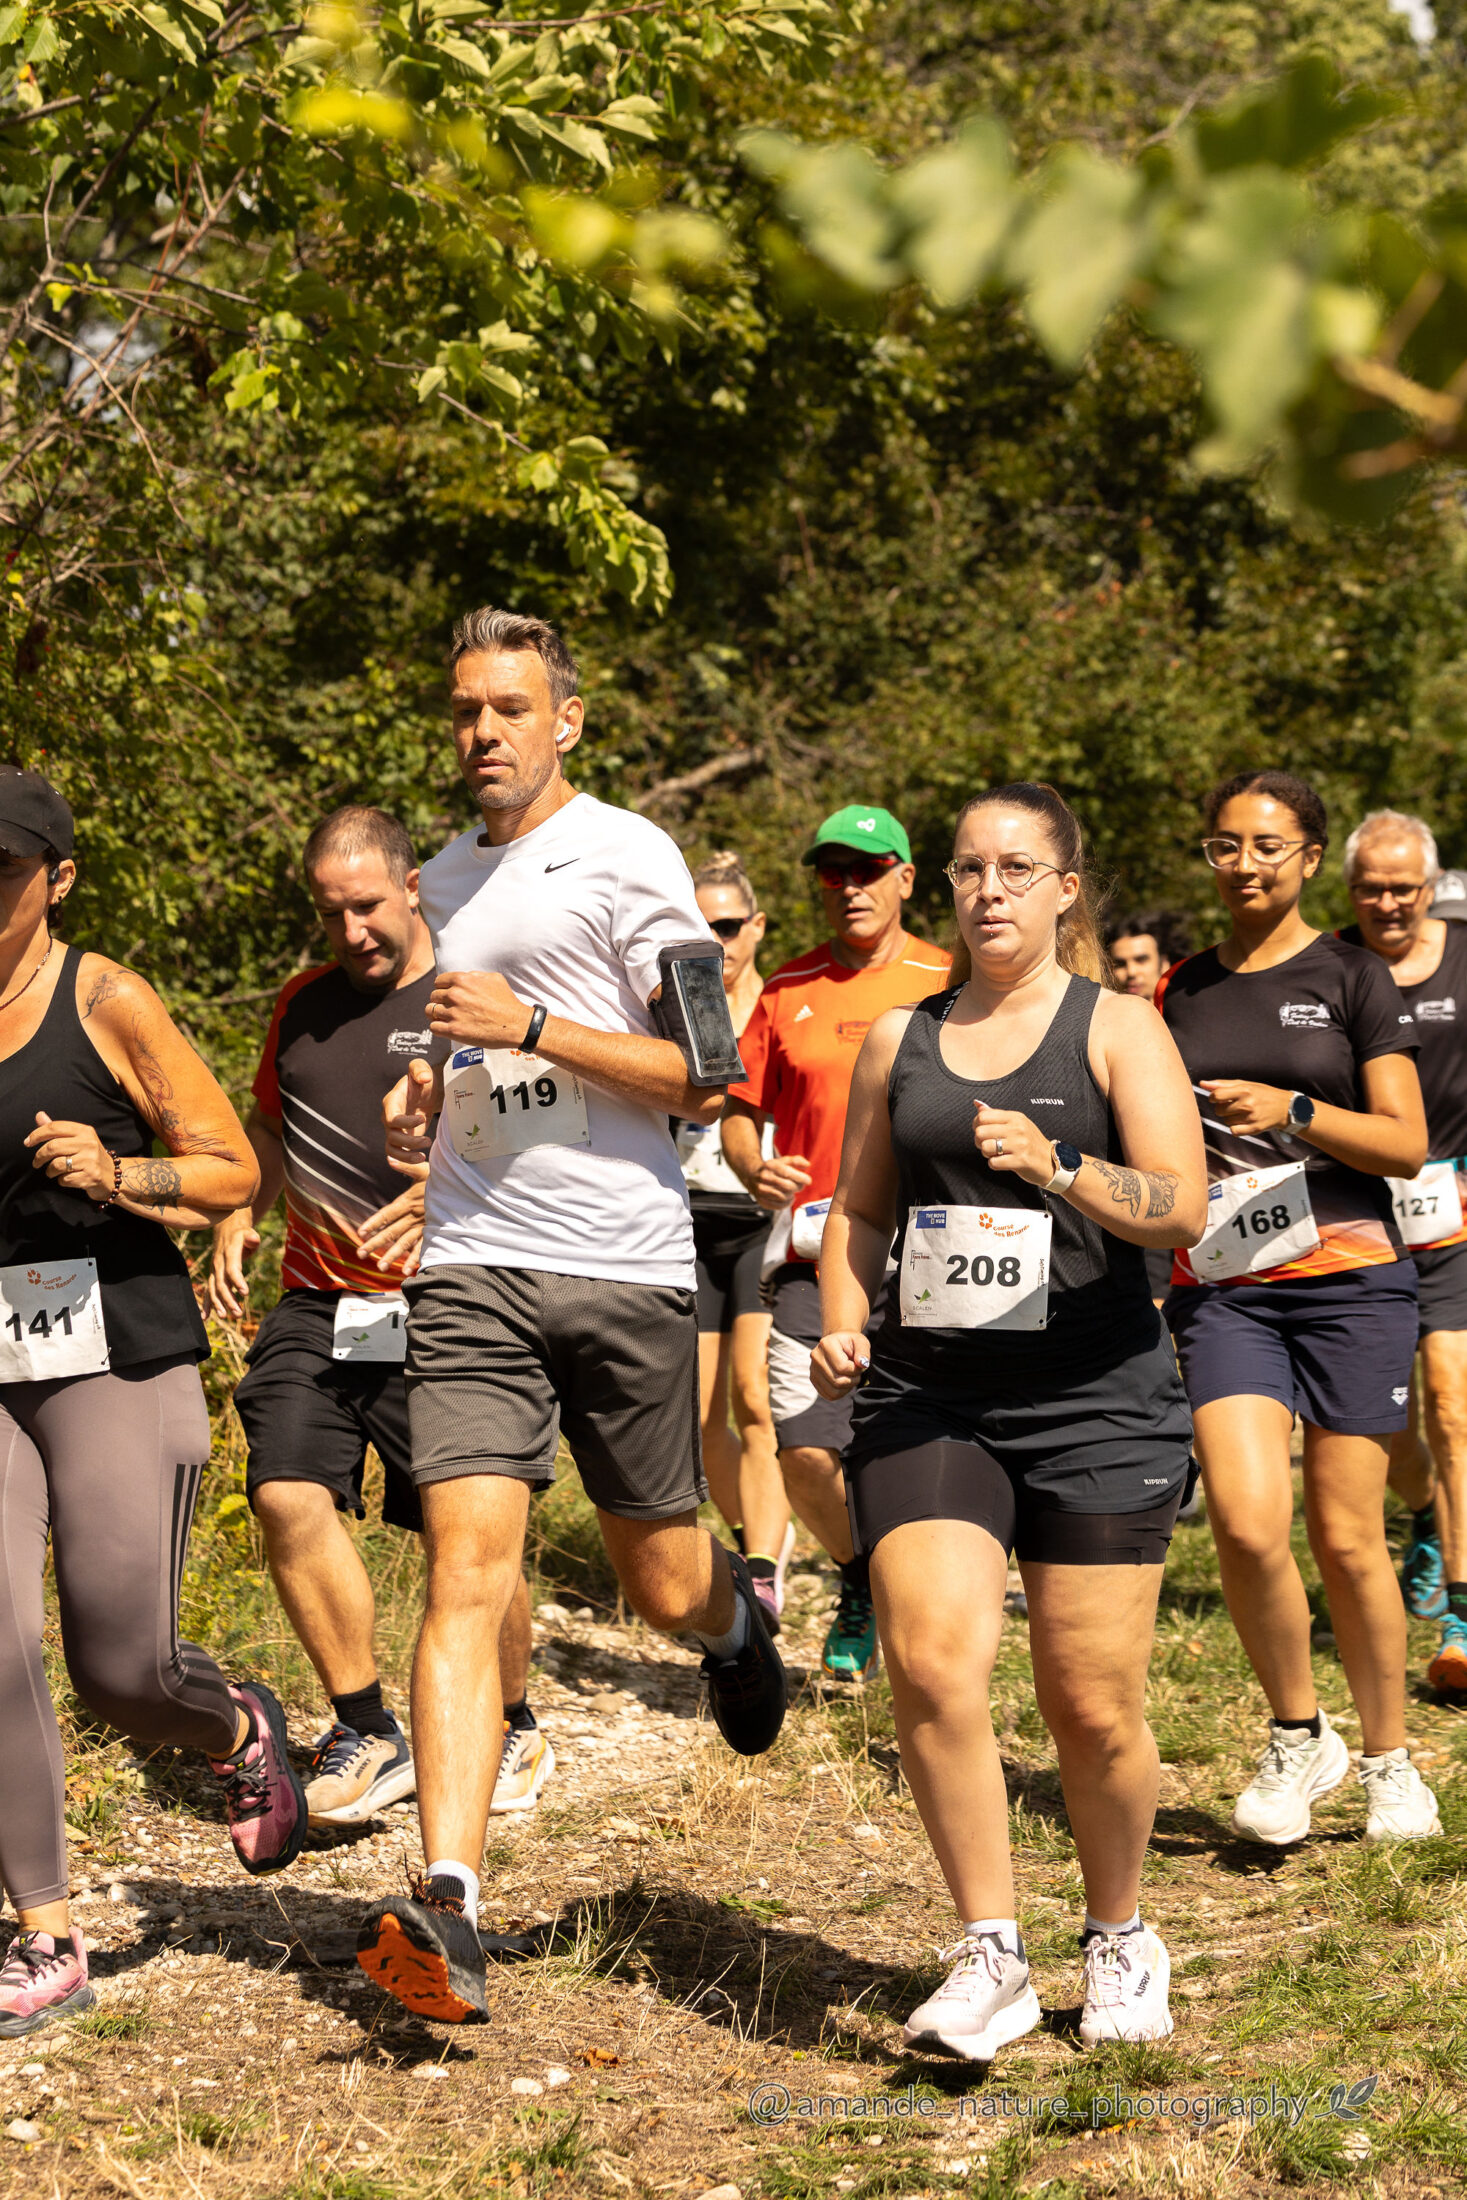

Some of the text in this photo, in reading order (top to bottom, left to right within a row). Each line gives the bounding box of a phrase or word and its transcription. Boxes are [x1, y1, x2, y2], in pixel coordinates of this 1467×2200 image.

[489, 1077, 557, 1115] 119
[1030, 1097, 1065, 1106] KIPRUN
[1232, 1204, 1291, 1240] 168
[1395, 1196, 1440, 1218] 127
[946, 1254, 1021, 1288] 208
[5, 1306, 73, 1342] 141
[1143, 1477, 1169, 1486] KIPRUN
[1133, 1970, 1151, 1998] KIPRU
